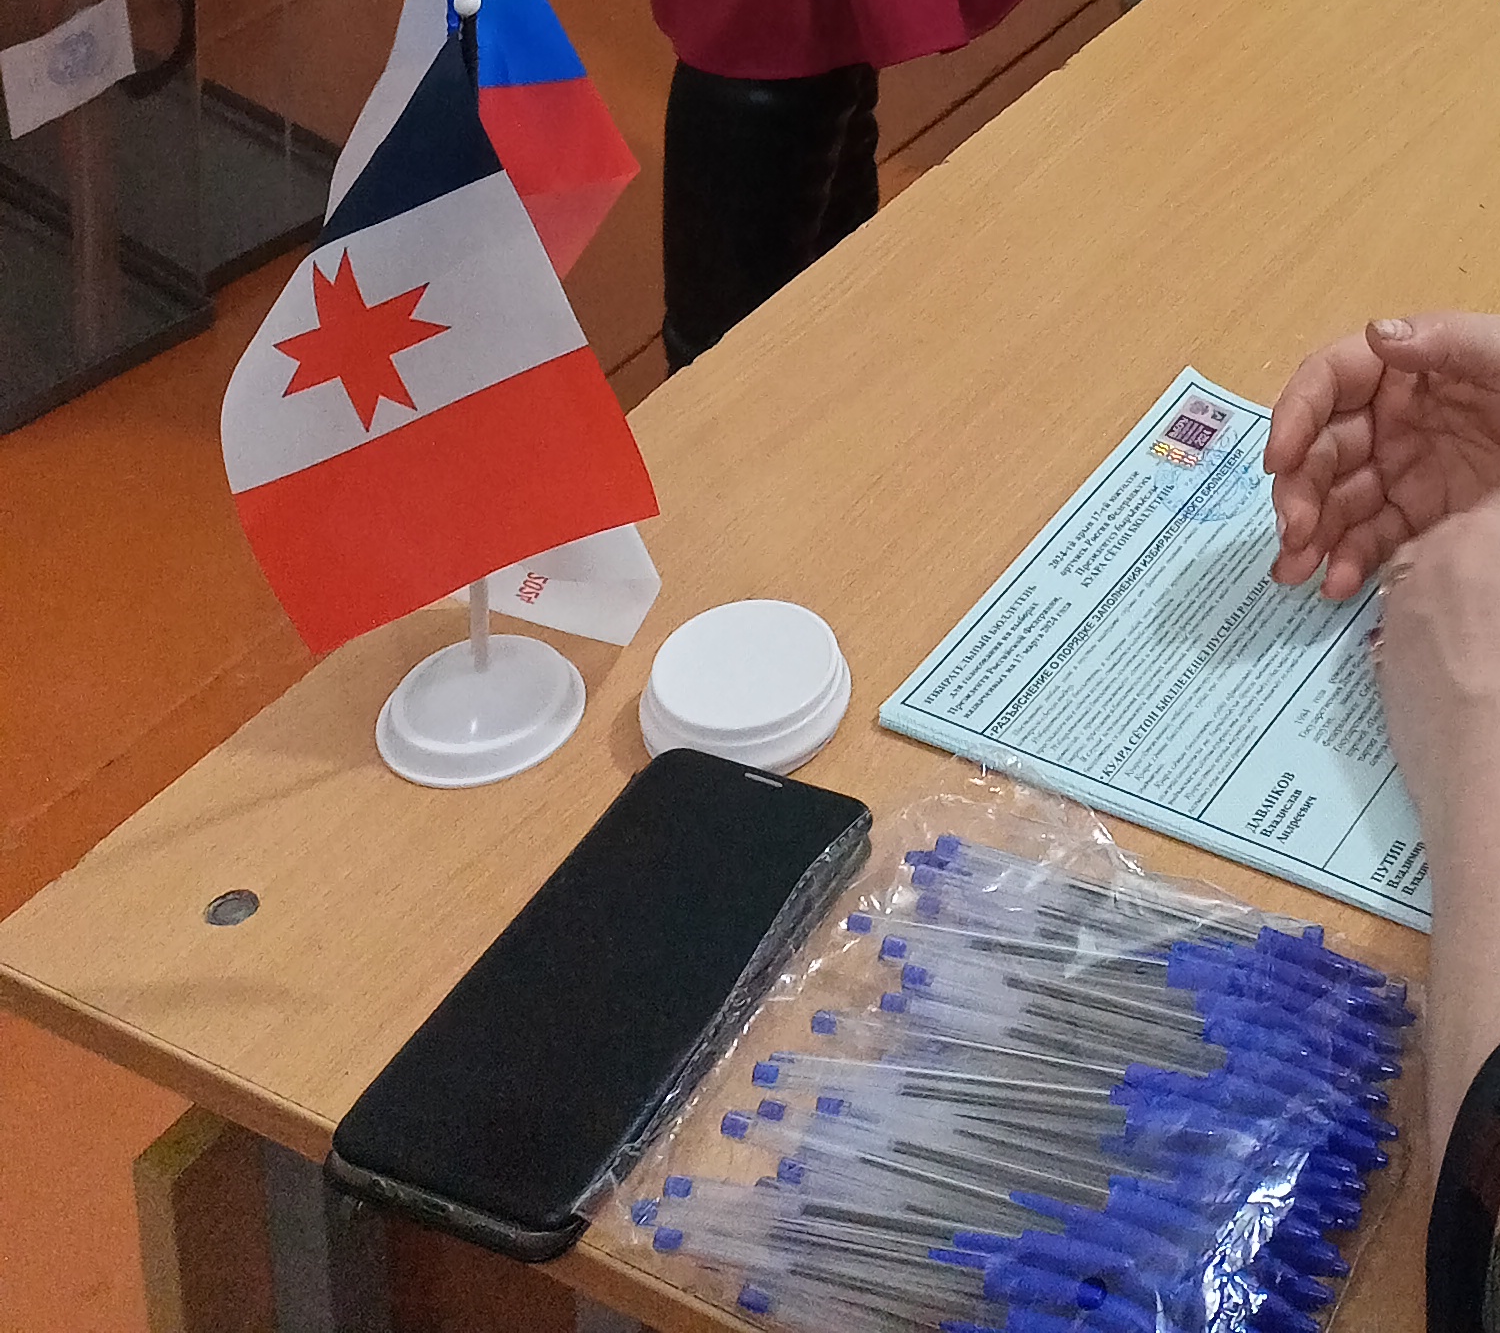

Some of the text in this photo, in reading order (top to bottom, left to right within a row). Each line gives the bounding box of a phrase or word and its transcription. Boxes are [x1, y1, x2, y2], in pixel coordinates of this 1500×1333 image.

[1079, 561, 1108, 588] КУАРА
[1125, 483, 1177, 532] БЮЛЛЕТЕНЬ
[988, 448, 1247, 734] РАЗЪЯСНЕНИЕ О ПОРЯДКЕ ЗАПОЛНЕНИЯ ИЗБИРАТЕЛЬНОГО БЮЛЛЕТЕНЯ
[1007, 600, 1042, 632] выборах
[923, 583, 1039, 705] ИЗБИРАТЕЛЬНЫЙ БЮЛЛЕТЕНЬ
[1020, 632, 1046, 654] марта
[1038, 616, 1059, 633] 2024
[946, 672, 991, 715] Президента
[984, 633, 1027, 674] Российской
[1099, 745, 1133, 777] КУАРА
[1243, 768, 1296, 834] ДАВАНКОВ
[1259, 786, 1303, 838] Владислав
[1274, 793, 1317, 845] Андреевич
[1370, 839, 1407, 883] ПУТИН
[1385, 839, 1429, 890] Владимир
